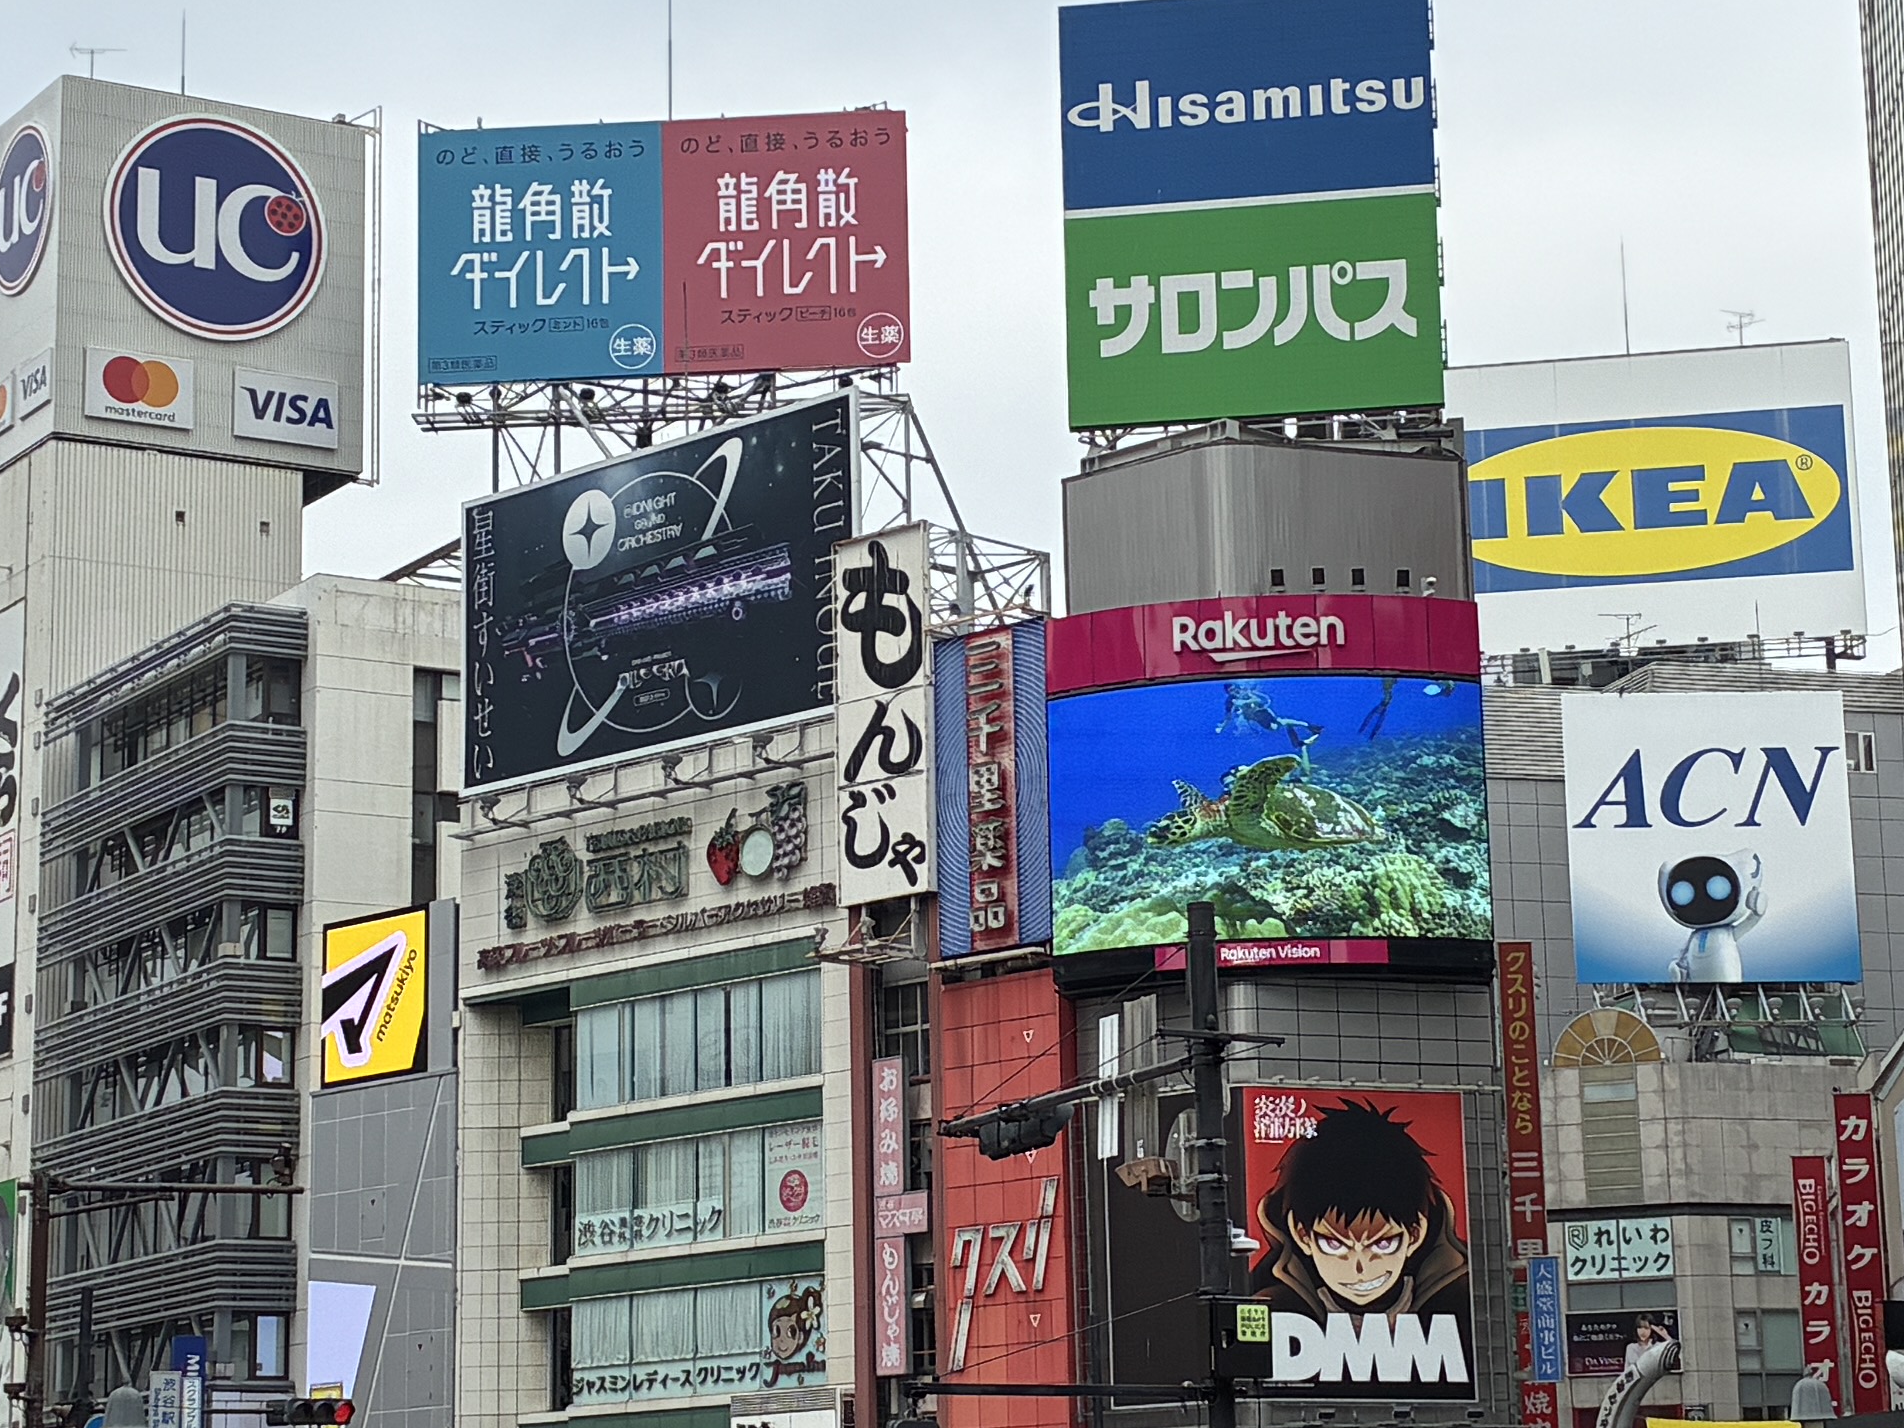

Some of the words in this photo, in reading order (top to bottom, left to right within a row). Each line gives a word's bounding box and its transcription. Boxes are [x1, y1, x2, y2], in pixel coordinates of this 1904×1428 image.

[1066, 76, 1426, 132] Hisamitsu
[436, 138, 646, 167] のど、直接、うるおう
[679, 126, 892, 155] のど、直接、うるおう
[471, 178, 613, 243] 龍角散
[715, 168, 859, 233] 龍角散
[450, 247, 642, 309] ダイレクト
[697, 237, 888, 298] ダイレクト
[473, 316, 547, 336] スティック
[720, 305, 794, 325] スティック
[859, 323, 902, 347] 生薬
[1088, 258, 1418, 358] サロンパス
[612, 333, 655, 359] 生薬
[21, 363, 48, 401] VISA
[240, 385, 335, 431] VISA
[104, 403, 177, 424] mastercard
[810, 408, 845, 534] TAKU
[1468, 458, 1816, 541] IKEA
[471, 508, 496, 779] 星街すいせい
[1171, 609, 1346, 656] Rakuten
[841, 539, 926, 888] もんじゃ
[966, 637, 1007, 933] 三千里薬品
[1572, 745, 1841, 829] ACN
[1218, 945, 1278, 964] Rakuten
[1277, 944, 1322, 961] Vision
[375, 947, 419, 1045] matsukiyo
[1504, 949, 1536, 1138] クスリのことなら
[1838, 1115, 1880, 1272] カラオケ
[1568, 1250, 1672, 1278] クリニック
[1592, 1223, 1672, 1247] れいわ
[1760, 1219, 1777, 1269] 皮フ科
[881, 1243, 901, 1368] もんじゃ焼
[1803, 1281, 1836, 1383] カラオ
[1271, 1311, 1470, 1384] DMM
[573, 1362, 761, 1398] ジャスミンレディースクリニック
